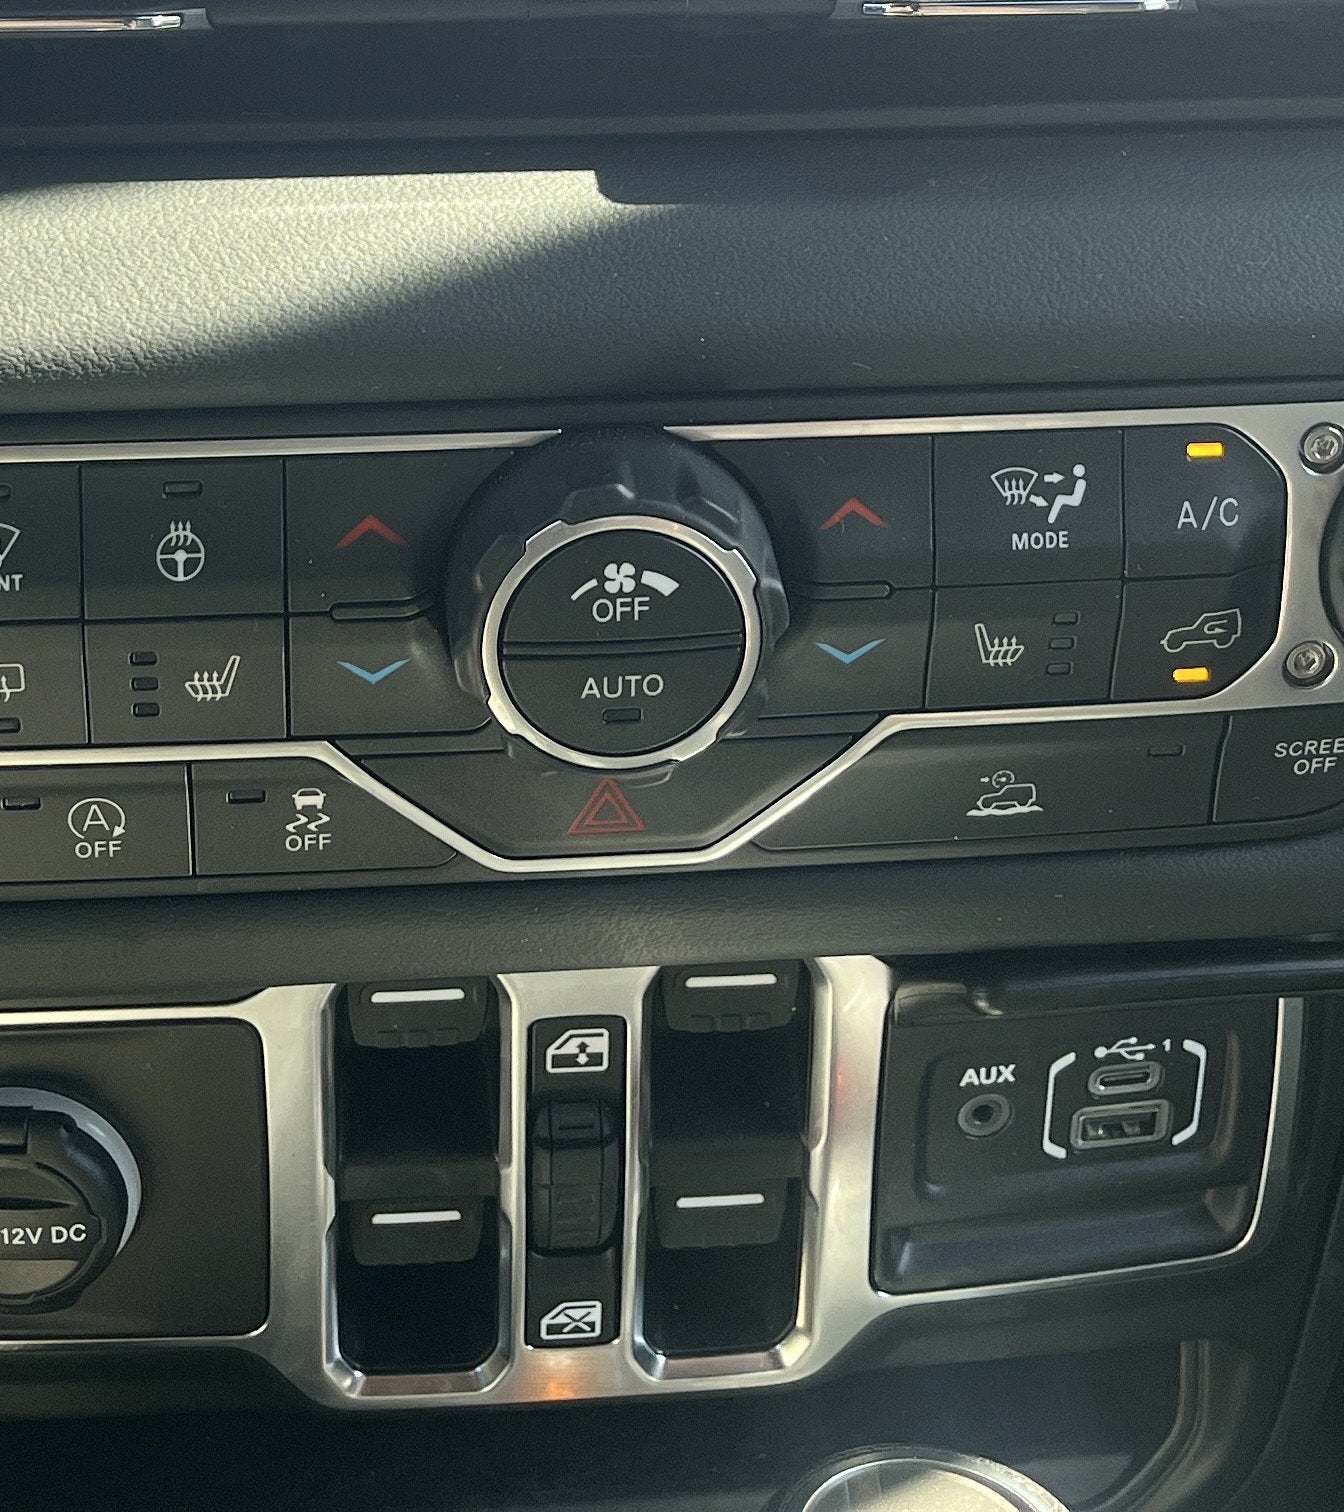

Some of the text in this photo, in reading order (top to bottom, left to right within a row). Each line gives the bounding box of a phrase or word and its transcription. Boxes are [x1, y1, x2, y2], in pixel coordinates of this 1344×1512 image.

[1177, 496, 1239, 531] A/C
[1011, 530, 1069, 551] MODE
[592, 596, 651, 623] OFF
[580, 673, 664, 700] AUTO
[1293, 756, 1338, 775] OFF
[74, 840, 123, 859] OFF
[285, 833, 332, 852] OFF
[959, 1063, 1017, 1087] AUX
[0, 1223, 87, 1245] 12V DC
